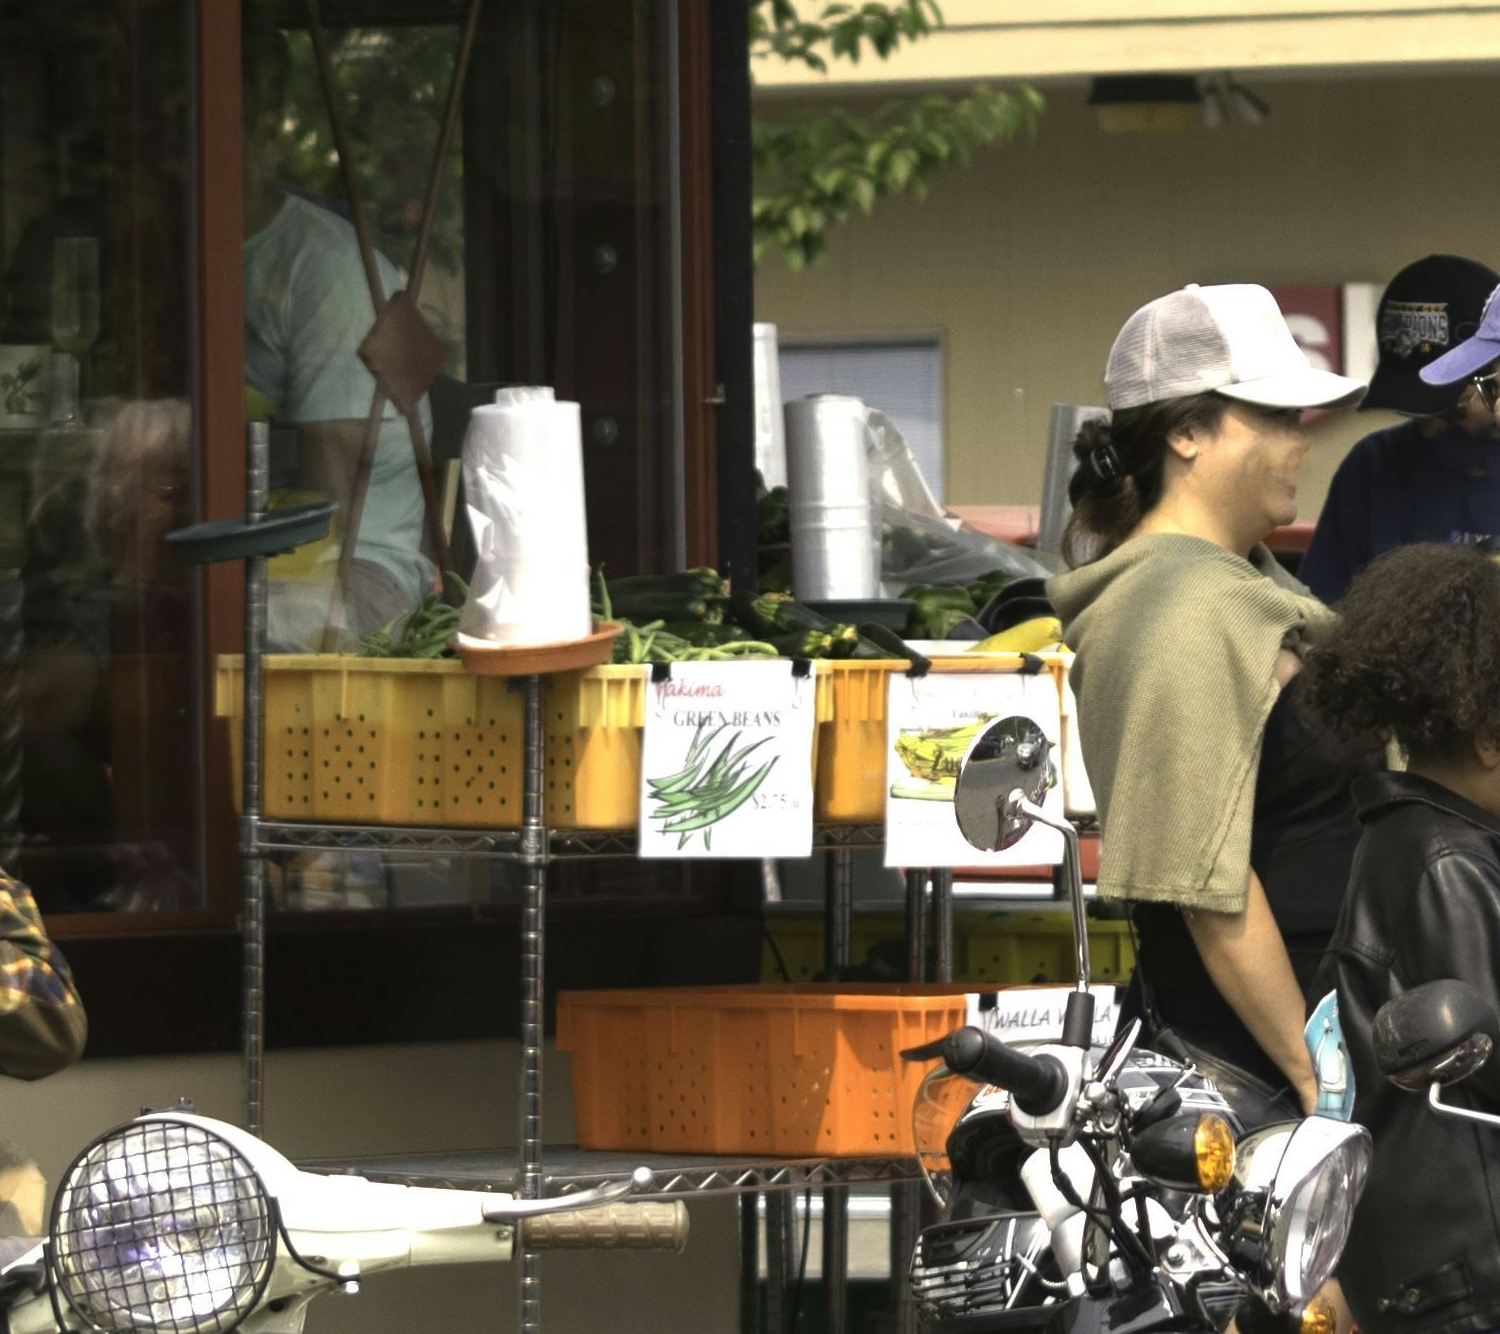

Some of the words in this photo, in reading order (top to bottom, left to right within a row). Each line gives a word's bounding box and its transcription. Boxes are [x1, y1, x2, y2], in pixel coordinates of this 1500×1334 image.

[673, 710, 728, 727] GREEN
[731, 710, 781, 727] BEANS
[994, 1010, 1051, 1029] WALLA
